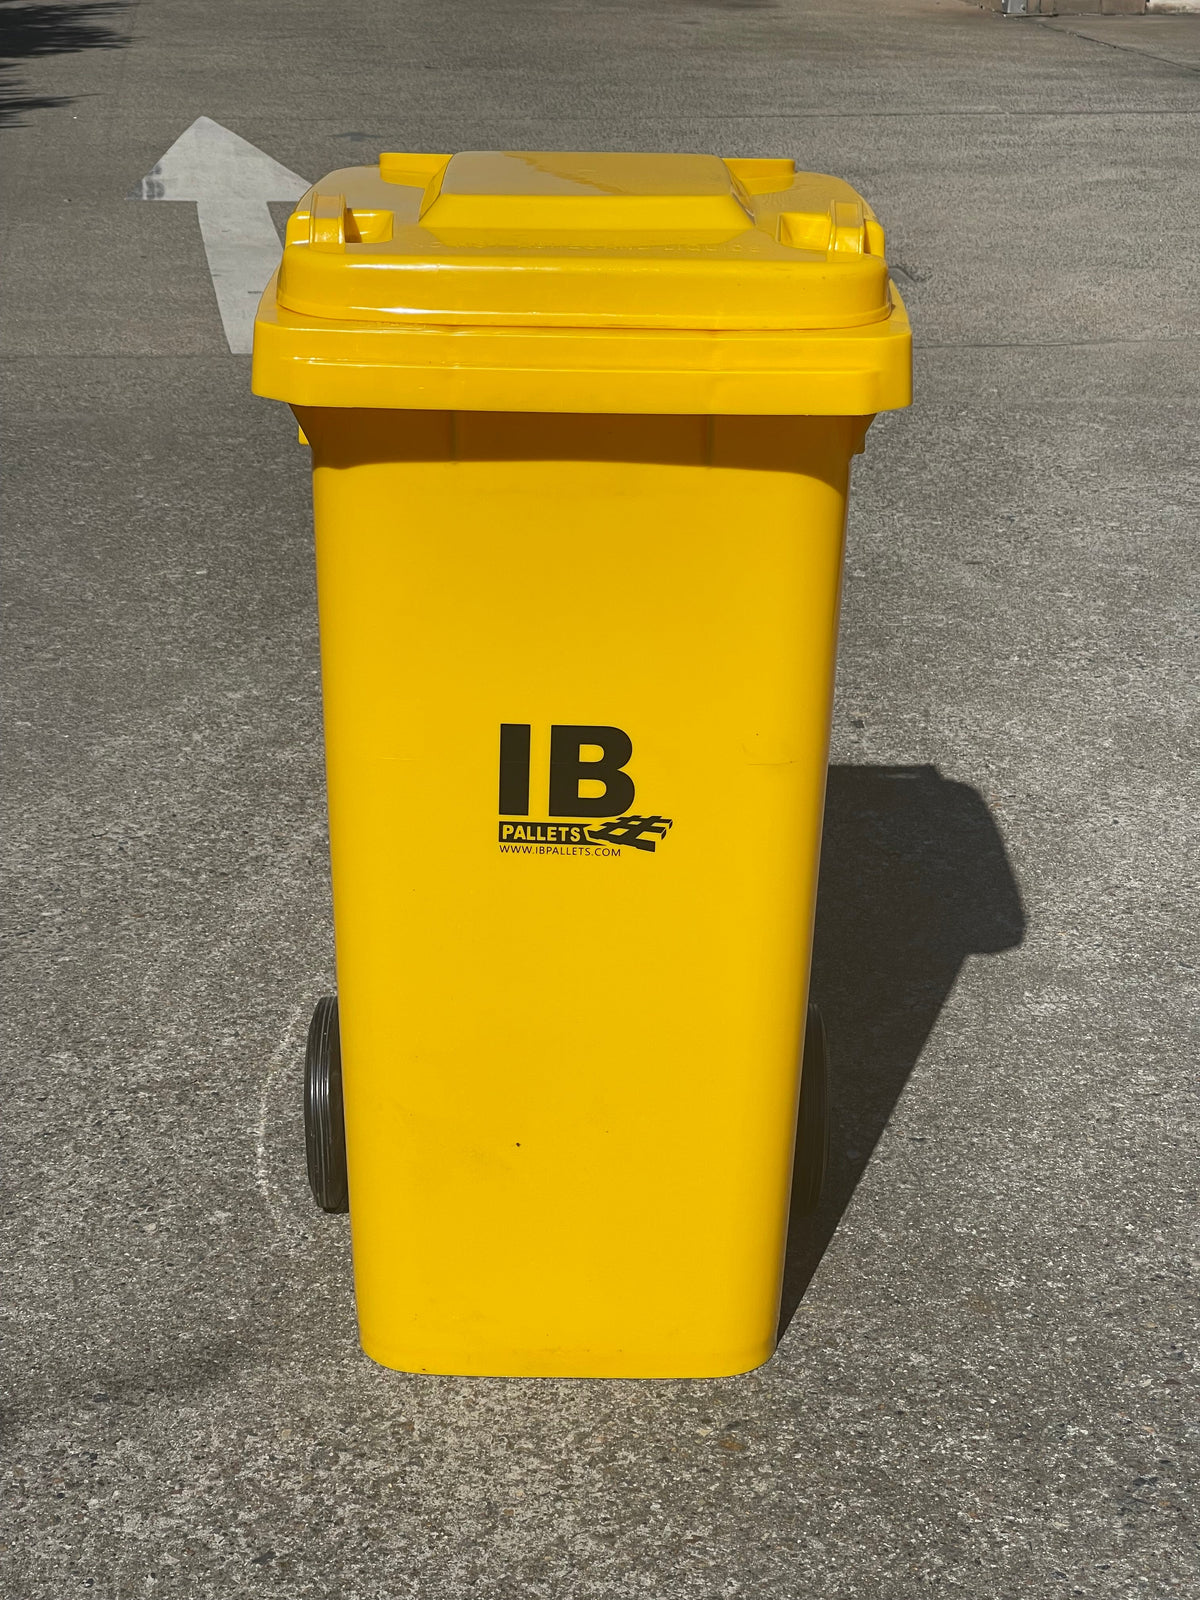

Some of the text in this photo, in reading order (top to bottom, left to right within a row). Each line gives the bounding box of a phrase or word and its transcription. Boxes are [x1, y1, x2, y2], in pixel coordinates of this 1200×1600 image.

[499, 724, 635, 818] IB
[502, 825, 581, 842] PALLETS
[499, 845, 621, 857] WWW.IBPALLETS.COM
